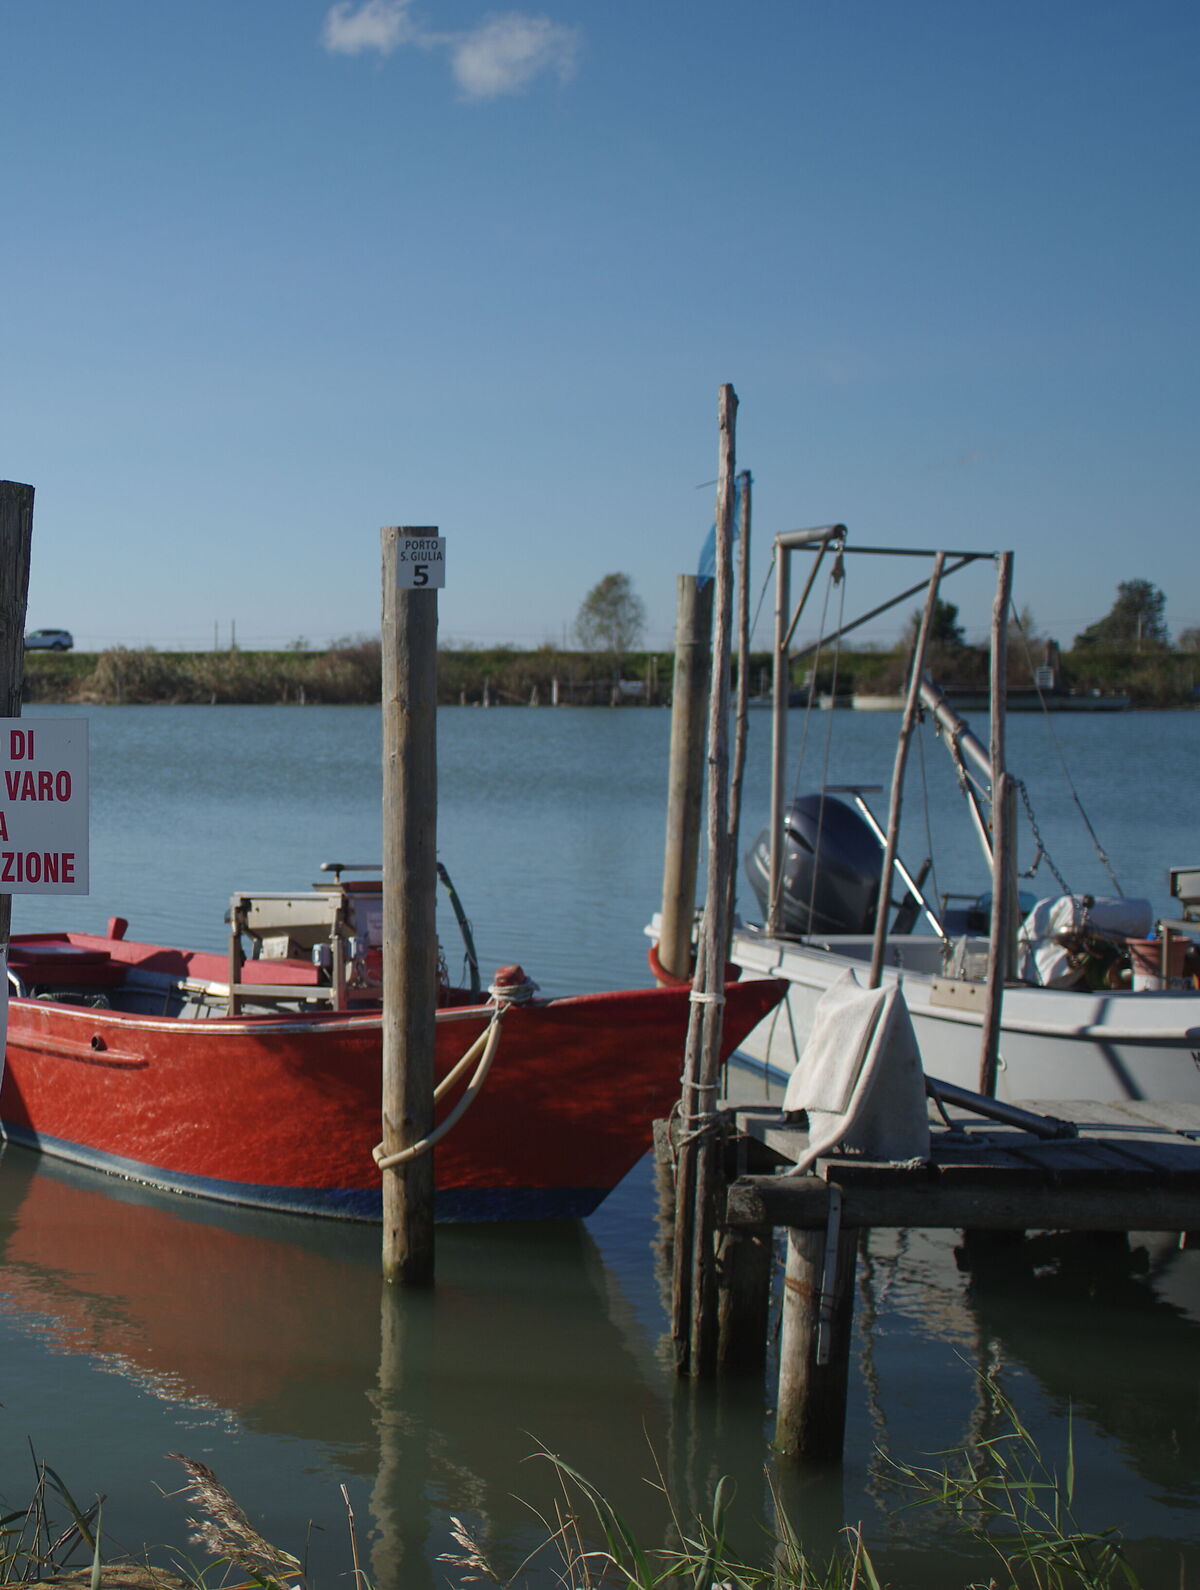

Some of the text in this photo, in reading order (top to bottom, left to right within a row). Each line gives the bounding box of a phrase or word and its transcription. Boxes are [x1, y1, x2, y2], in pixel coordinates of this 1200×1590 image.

[405, 540, 438, 550] PORTO
[400, 551, 443, 562] S. GIULIA
[413, 564, 429, 586] 5
[10, 730, 34, 760] DI
[5, 770, 72, 802] VARO
